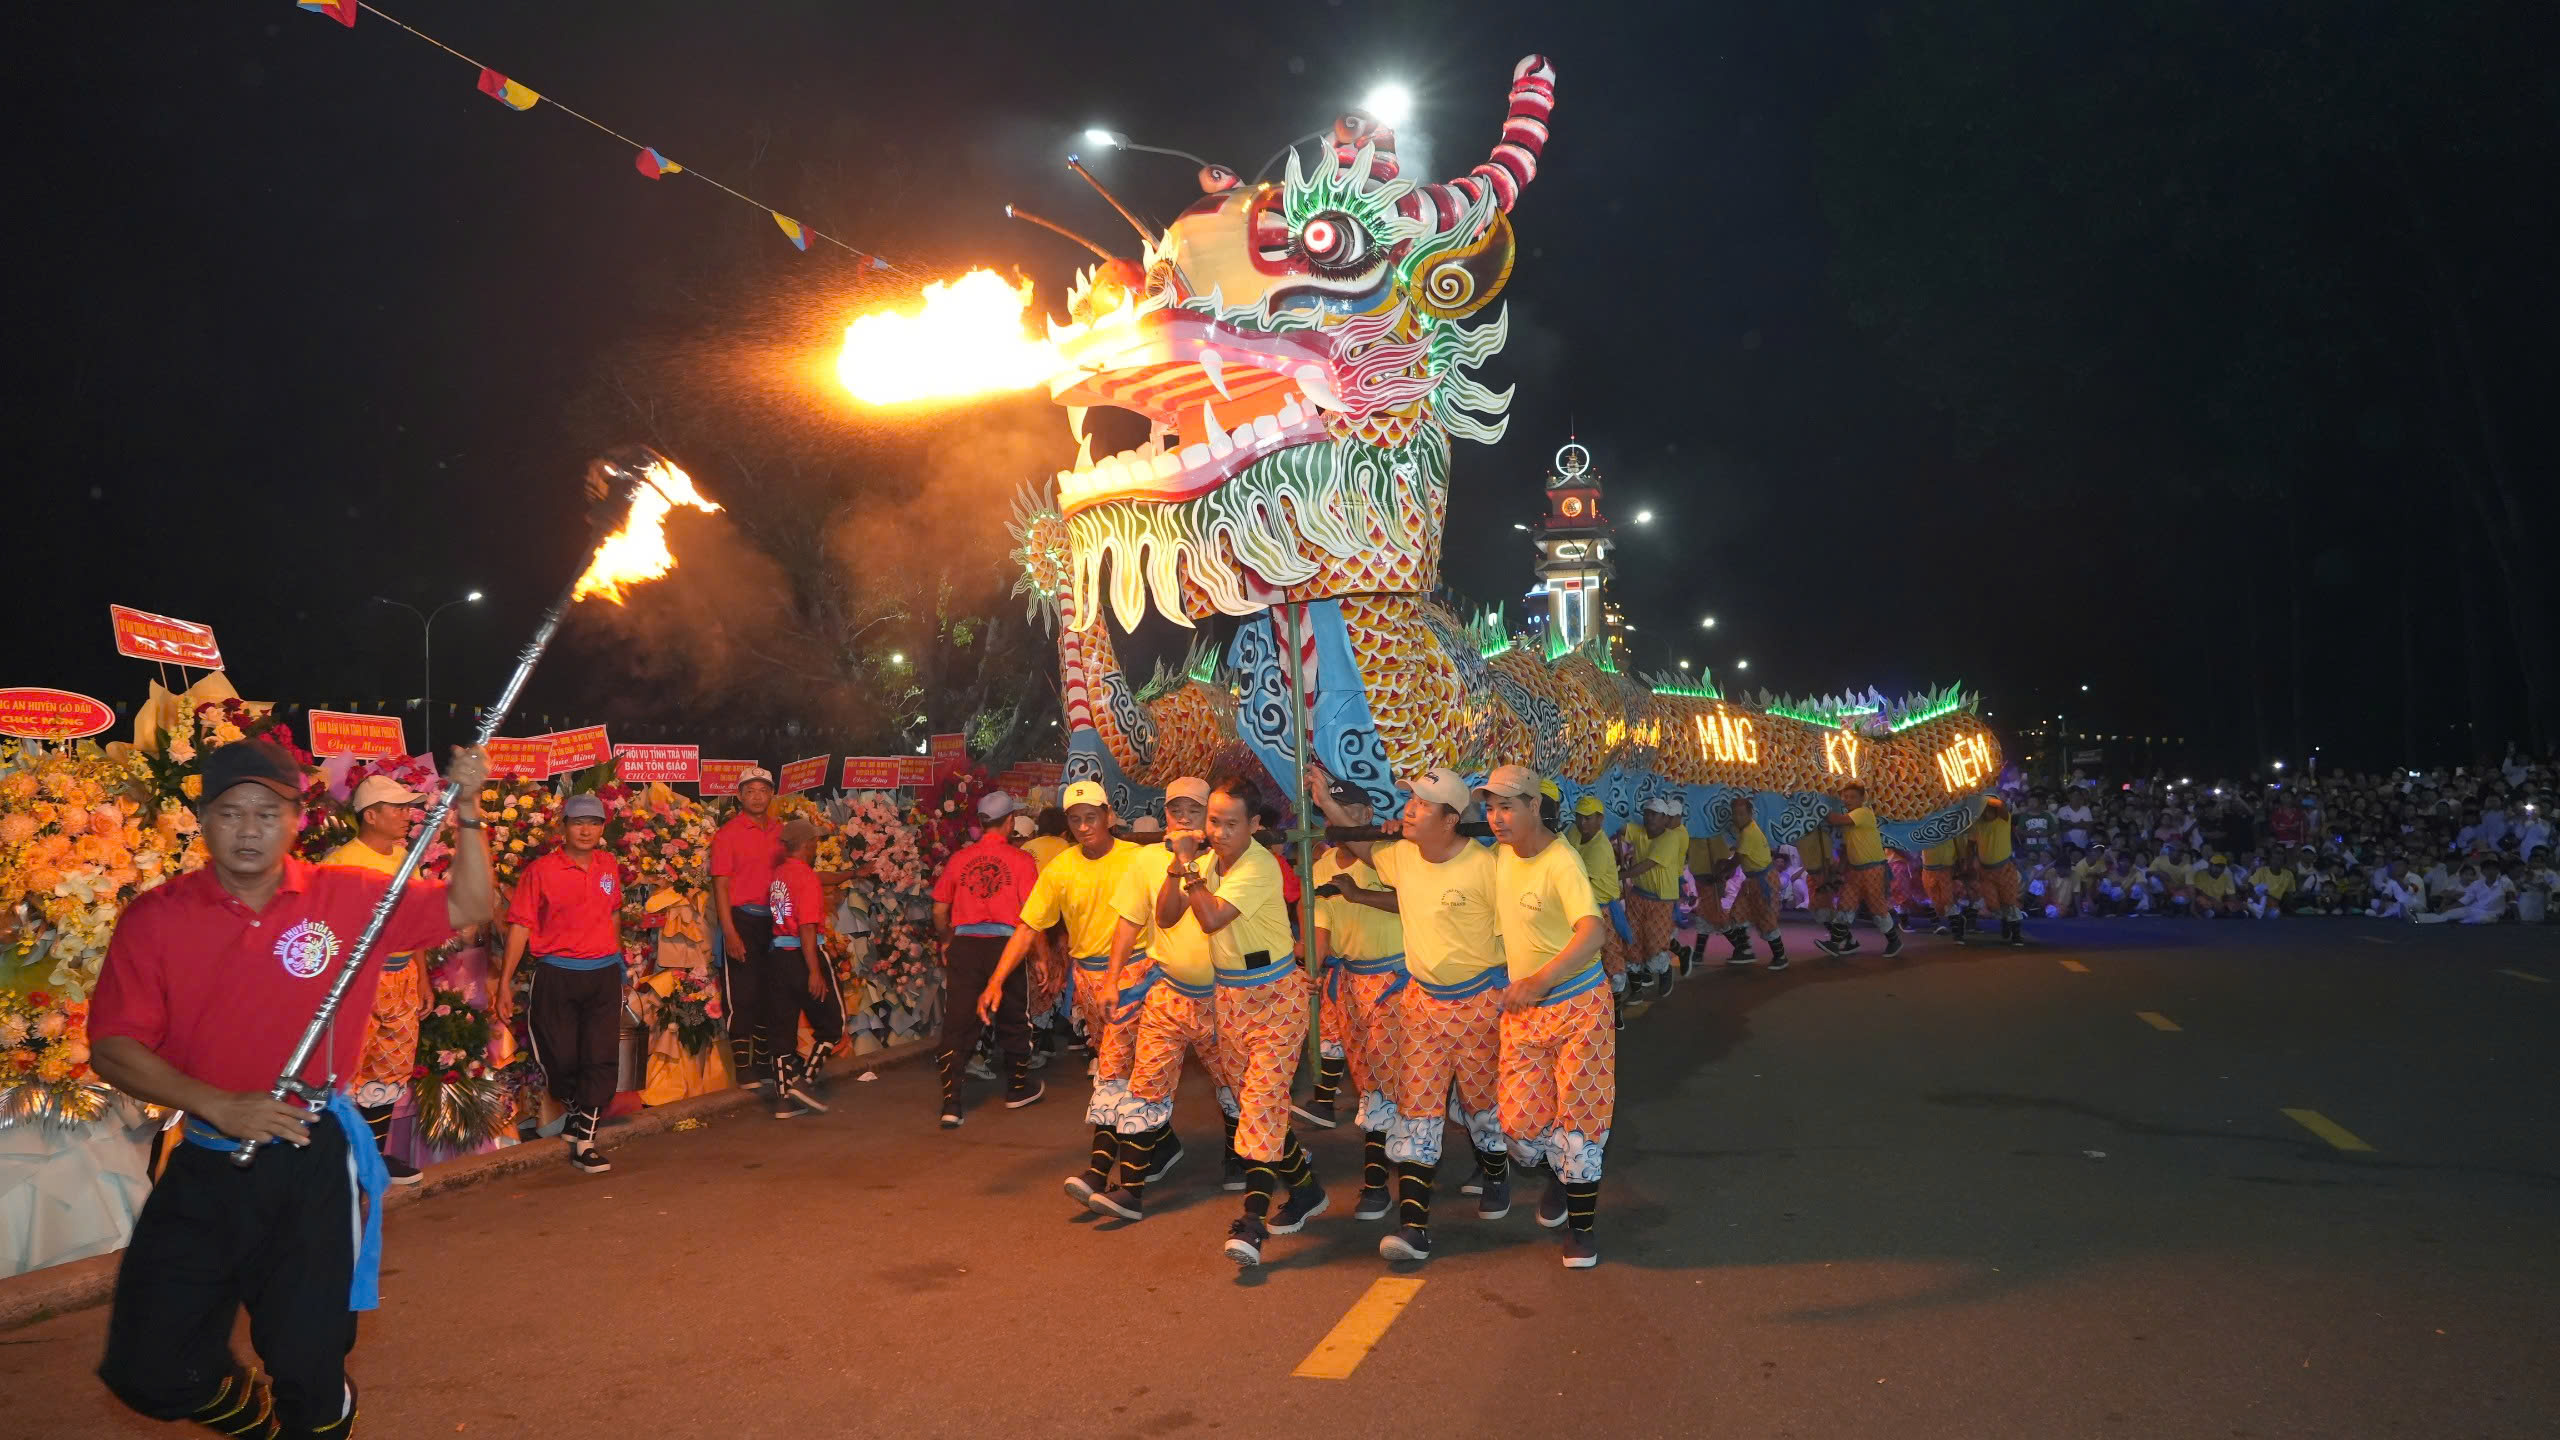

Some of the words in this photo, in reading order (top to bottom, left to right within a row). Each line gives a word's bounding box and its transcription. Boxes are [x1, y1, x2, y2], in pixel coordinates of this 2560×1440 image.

[12, 700, 26, 711] AN
[626, 747, 638, 761] NỘI
[640, 749, 649, 761] VỤ
[649, 747, 666, 760] TỈNH
[681, 750, 697, 760] VINH
[624, 761, 643, 771] BAN
[645, 760, 664, 771] TÔN
[666, 760, 688, 771] GIÁO
[1936, 733, 1993, 793] NIỆM
[626, 771, 654, 780] CHÚC
